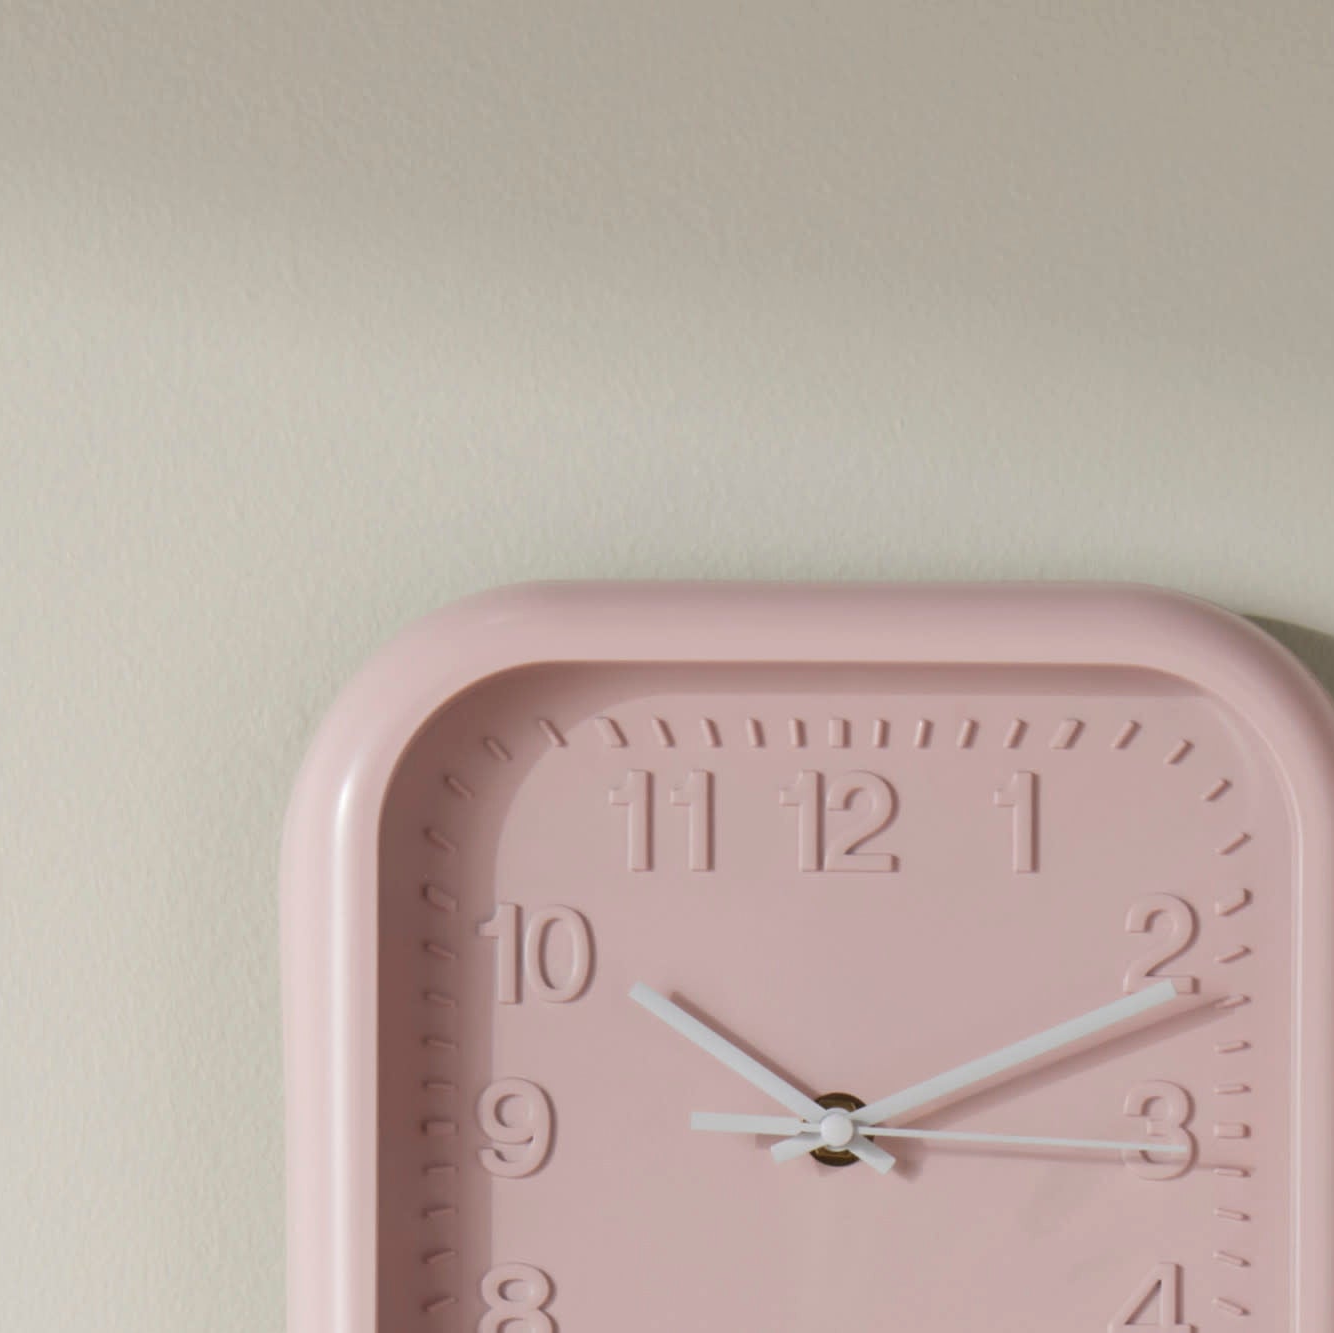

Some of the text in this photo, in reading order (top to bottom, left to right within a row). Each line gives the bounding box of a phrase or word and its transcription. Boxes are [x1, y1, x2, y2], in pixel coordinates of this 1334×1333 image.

[609, 769, 1041, 874] 11 12 1
[478, 903, 596, 1005] 10
[1123, 893, 1200, 996] 2
[477, 1077, 557, 1179] 9
[1123, 1080, 1198, 1181] 3
